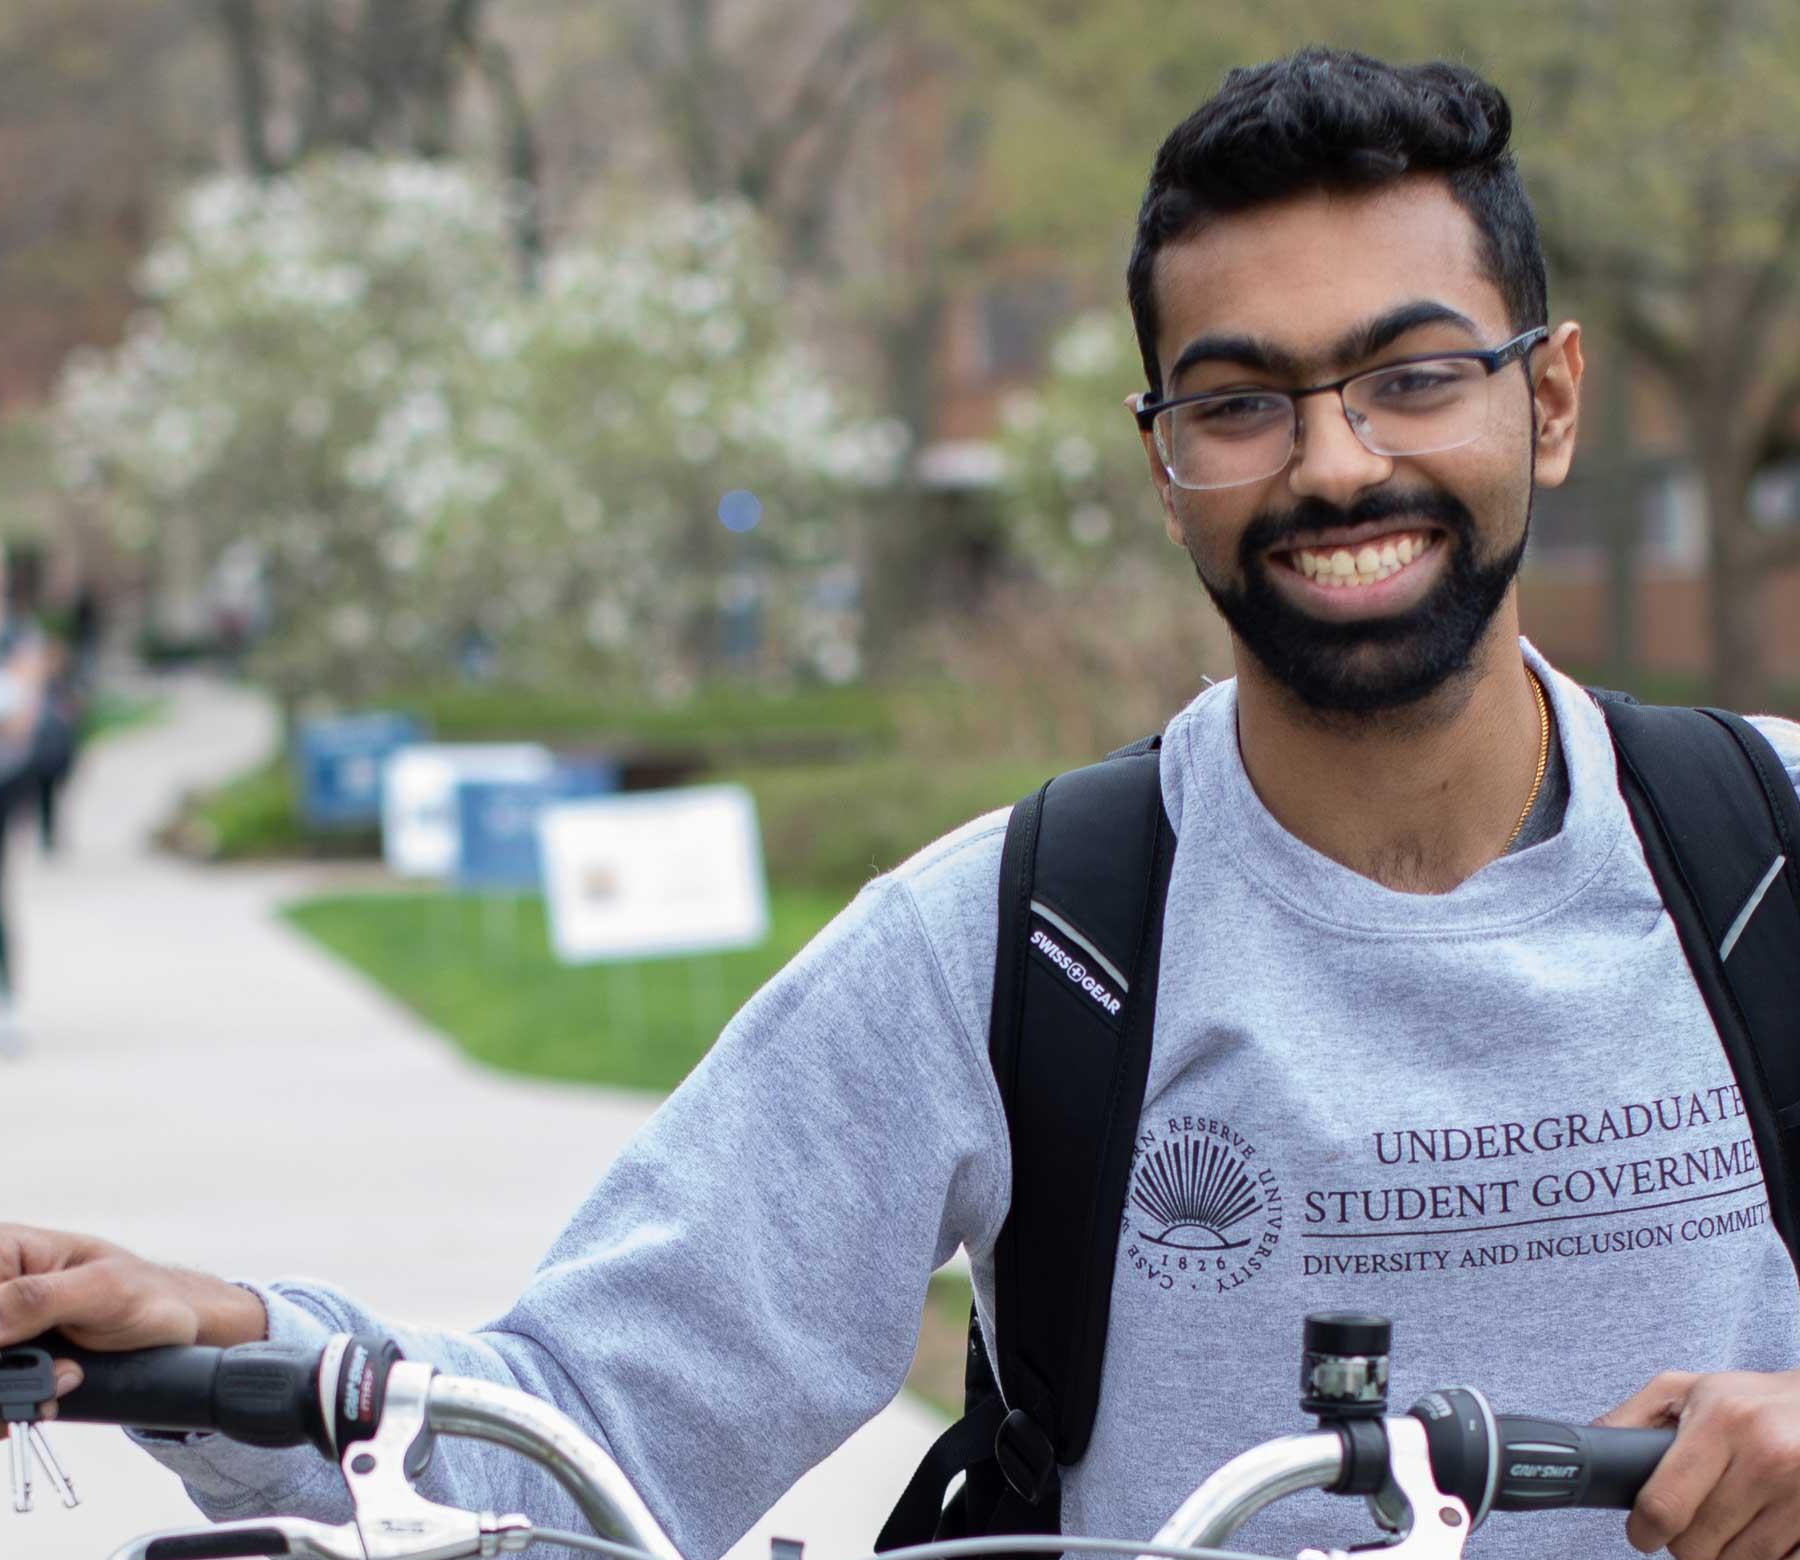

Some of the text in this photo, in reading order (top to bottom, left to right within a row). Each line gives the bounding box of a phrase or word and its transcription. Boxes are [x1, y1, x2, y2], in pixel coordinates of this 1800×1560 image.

[1030, 931, 1121, 1015] SWISS GEAR
[1168, 1116, 1256, 1160] RESERVE
[1372, 1084, 1746, 1164] UNDERGRADUATE
[1304, 1138, 1760, 1223] STUDENT GOVERNME
[1127, 1244, 1174, 1290] CASE
[1161, 1254, 1226, 1272] 1826
[1217, 1168, 1283, 1293] UNIVERSITY
[1303, 1200, 1768, 1276] DIVERSITY AND INCLUSION COMMIT
